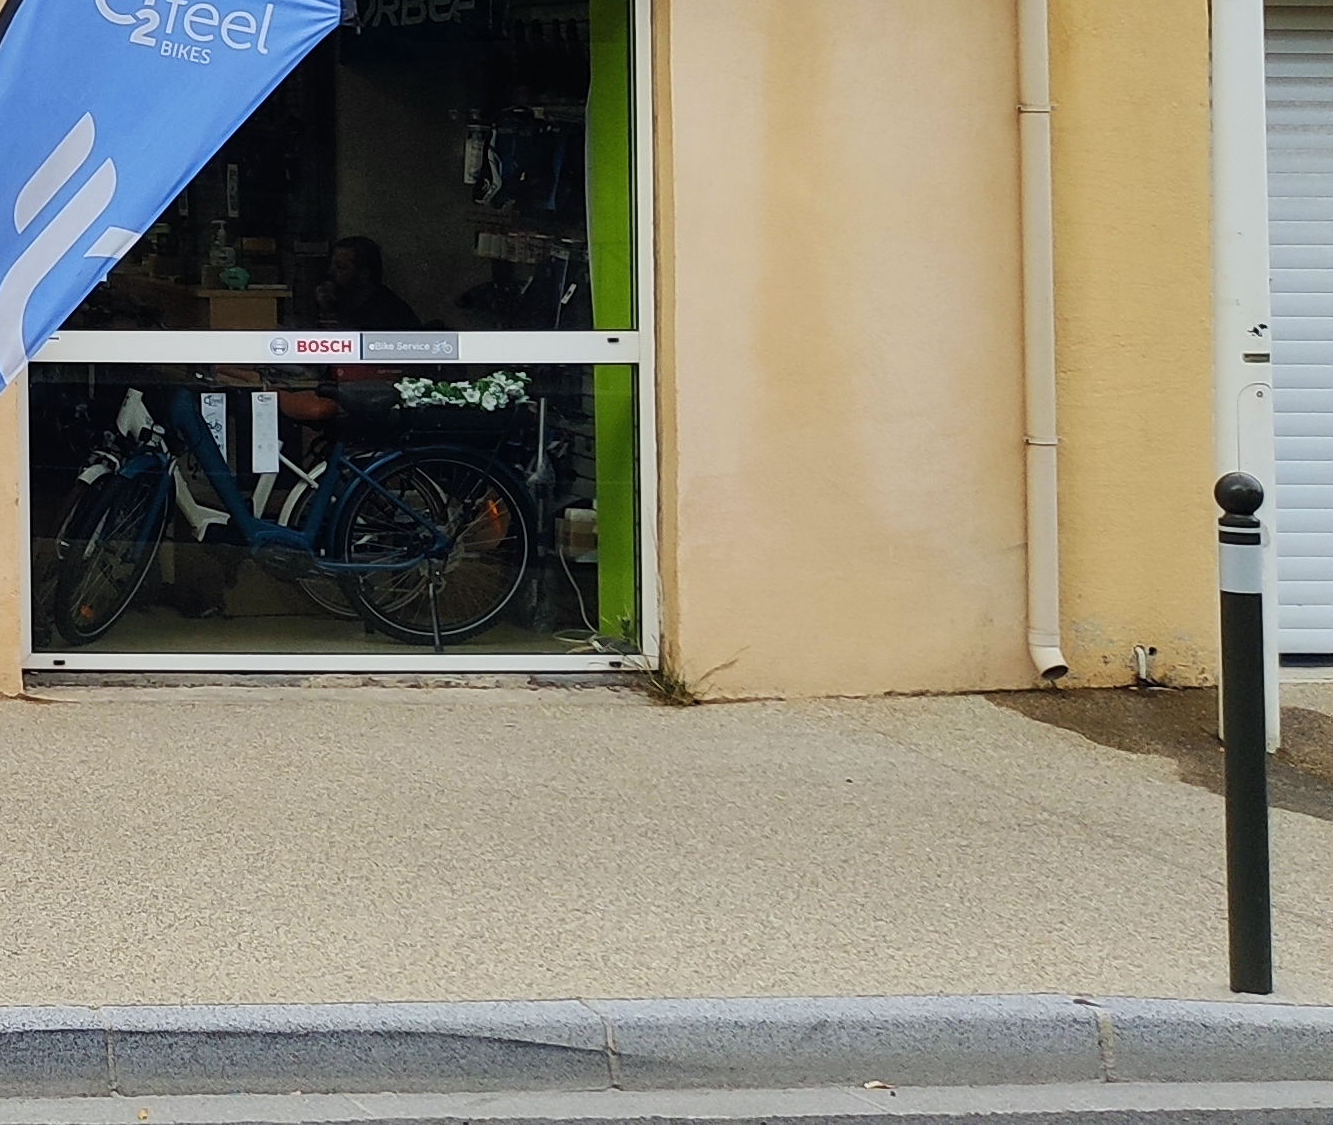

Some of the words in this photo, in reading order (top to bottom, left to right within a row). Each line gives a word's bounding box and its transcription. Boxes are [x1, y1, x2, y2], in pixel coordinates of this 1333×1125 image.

[160, 42, 213, 64] BIKES
[297, 340, 353, 353] BOSCH
[368, 341, 394, 351] eBike
[396, 341, 431, 351] Service
